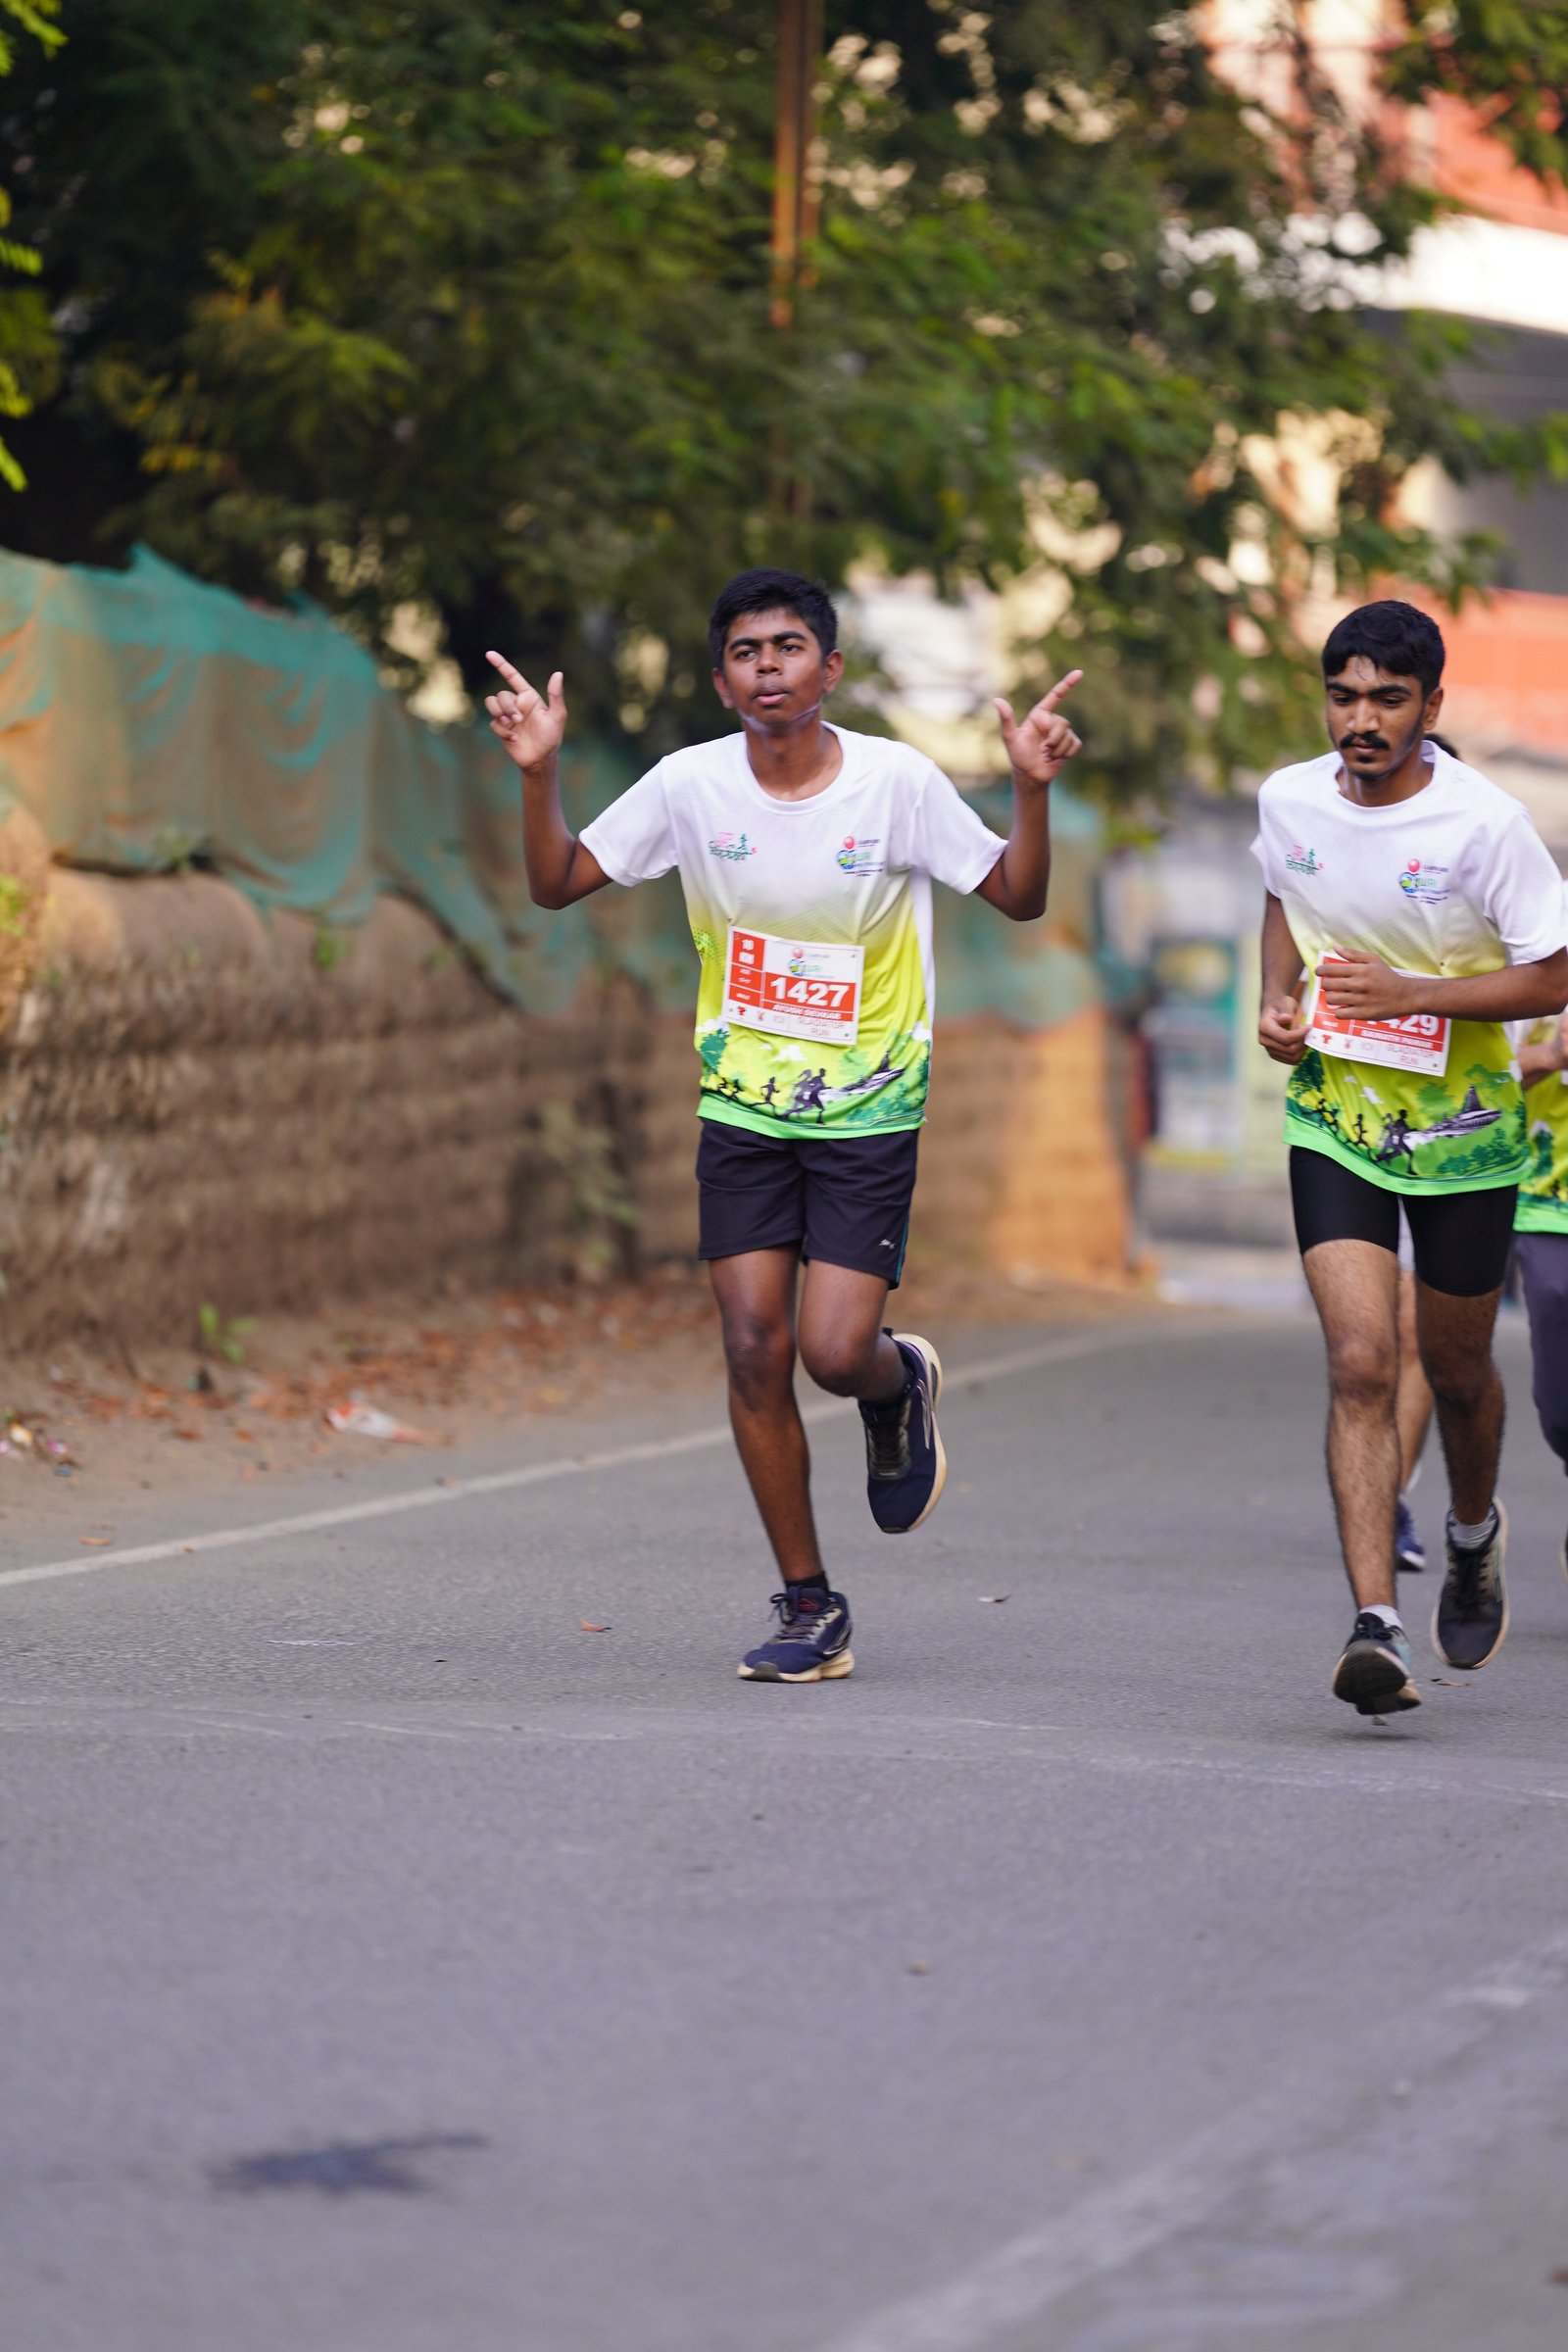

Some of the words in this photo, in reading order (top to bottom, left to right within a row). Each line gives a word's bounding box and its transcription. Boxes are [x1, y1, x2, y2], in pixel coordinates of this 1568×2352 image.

[770, 977, 850, 1007] 1427
[1366, 1013, 1440, 1036] 29
[1387, 1044, 1436, 1058] GLADIATOR
[1399, 1055, 1420, 1065] RUN
